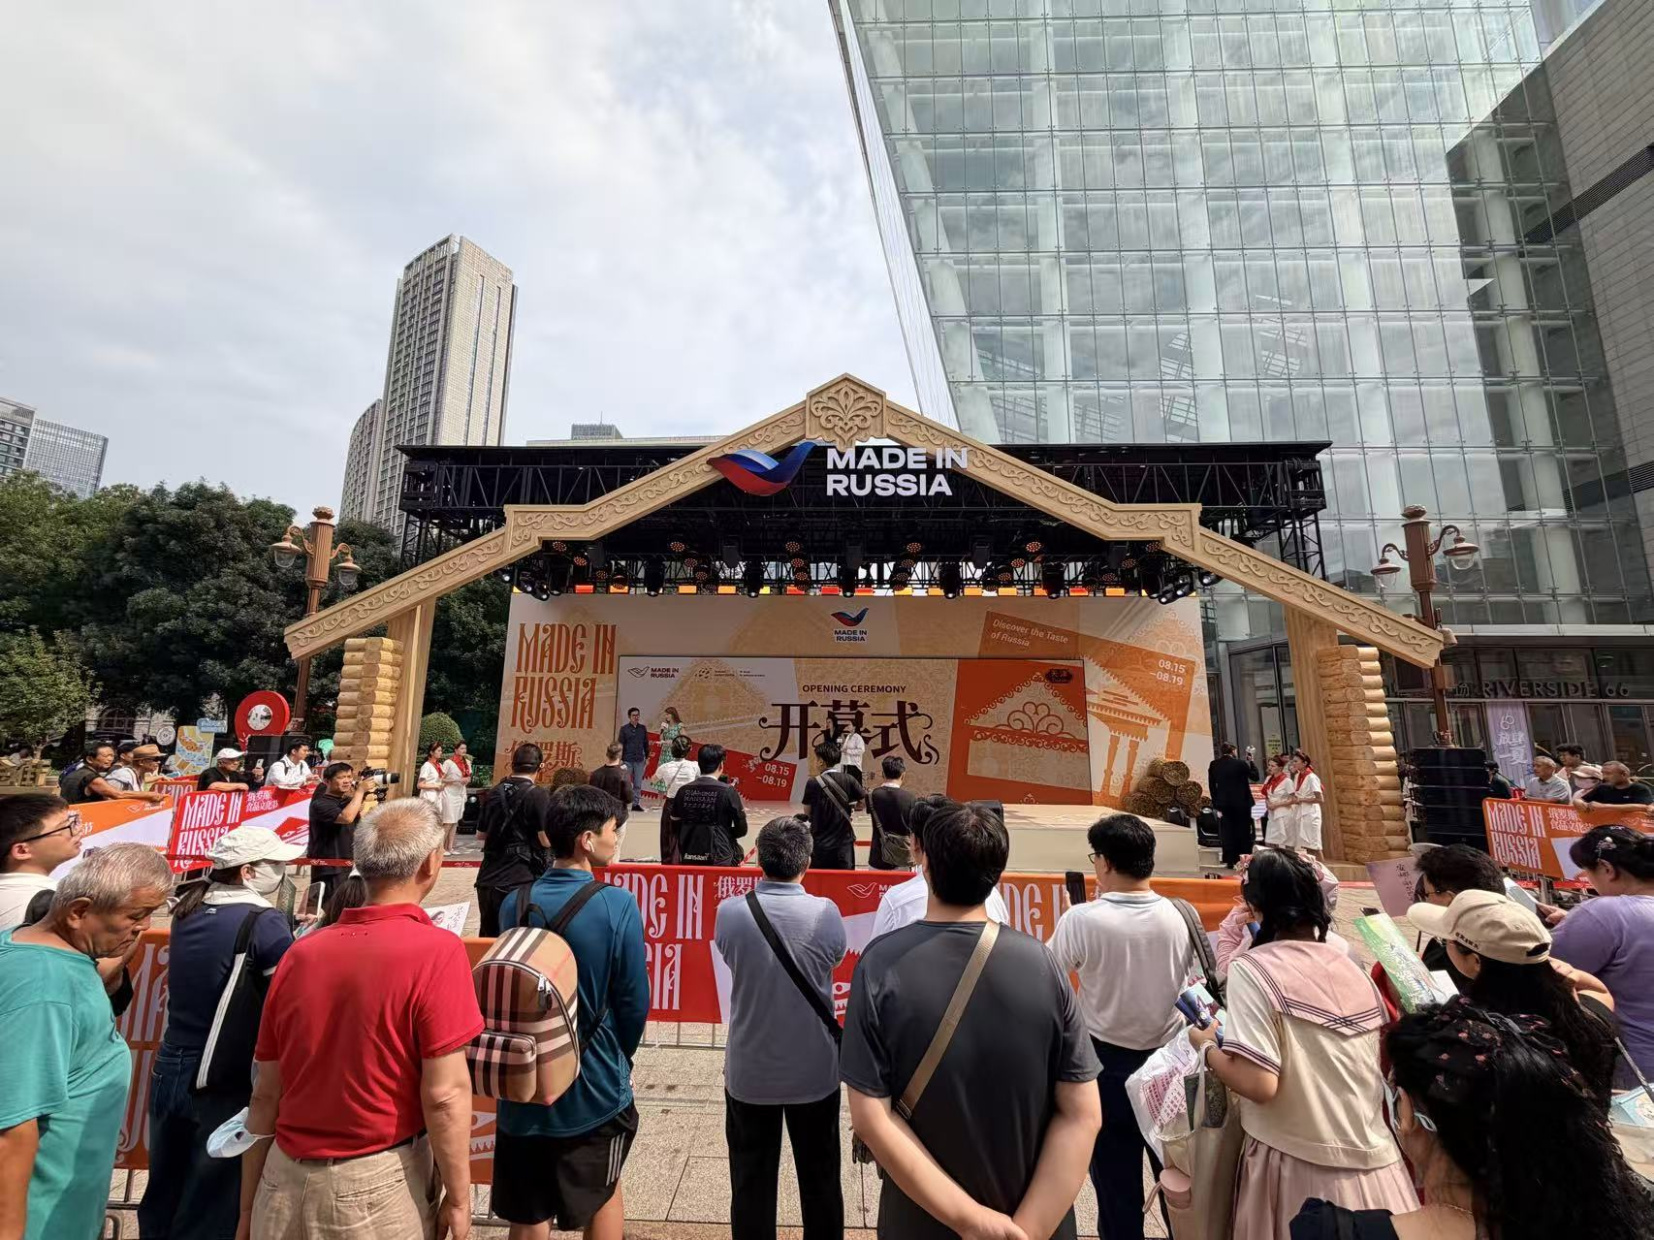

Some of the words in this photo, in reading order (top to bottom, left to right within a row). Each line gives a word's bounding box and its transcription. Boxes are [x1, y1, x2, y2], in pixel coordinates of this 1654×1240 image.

[826, 447, 927, 469] MADE
[935, 447, 968, 469] IN
[826, 474, 952, 496] RUSSIA
[990, 631, 1002, 639] of
[1001, 633, 1030, 647] Russia
[992, 618, 1030, 634] Discover
[1030, 628, 1045, 638] the
[1046, 631, 1069, 644] Taste
[516, 623, 586, 675] MADE
[592, 624, 617, 675] IN
[1158, 659, 1186, 673] 08.15
[802, 685, 848, 693] OPENING
[850, 685, 907, 694] CEREMONY
[1482, 681, 1597, 698] RIVERSIDE
[1605, 682, 1630, 697] 66
[510, 676, 597, 734] RUSSIA
[764, 763, 790, 776] 08.15
[181, 793, 227, 830] MADE
[227, 790, 243, 824] IN
[1486, 801, 1528, 835] MADE
[1527, 805, 1547, 838] IN
[1490, 832, 1542, 870] RUSSIA
[675, 873, 705, 940] IN
